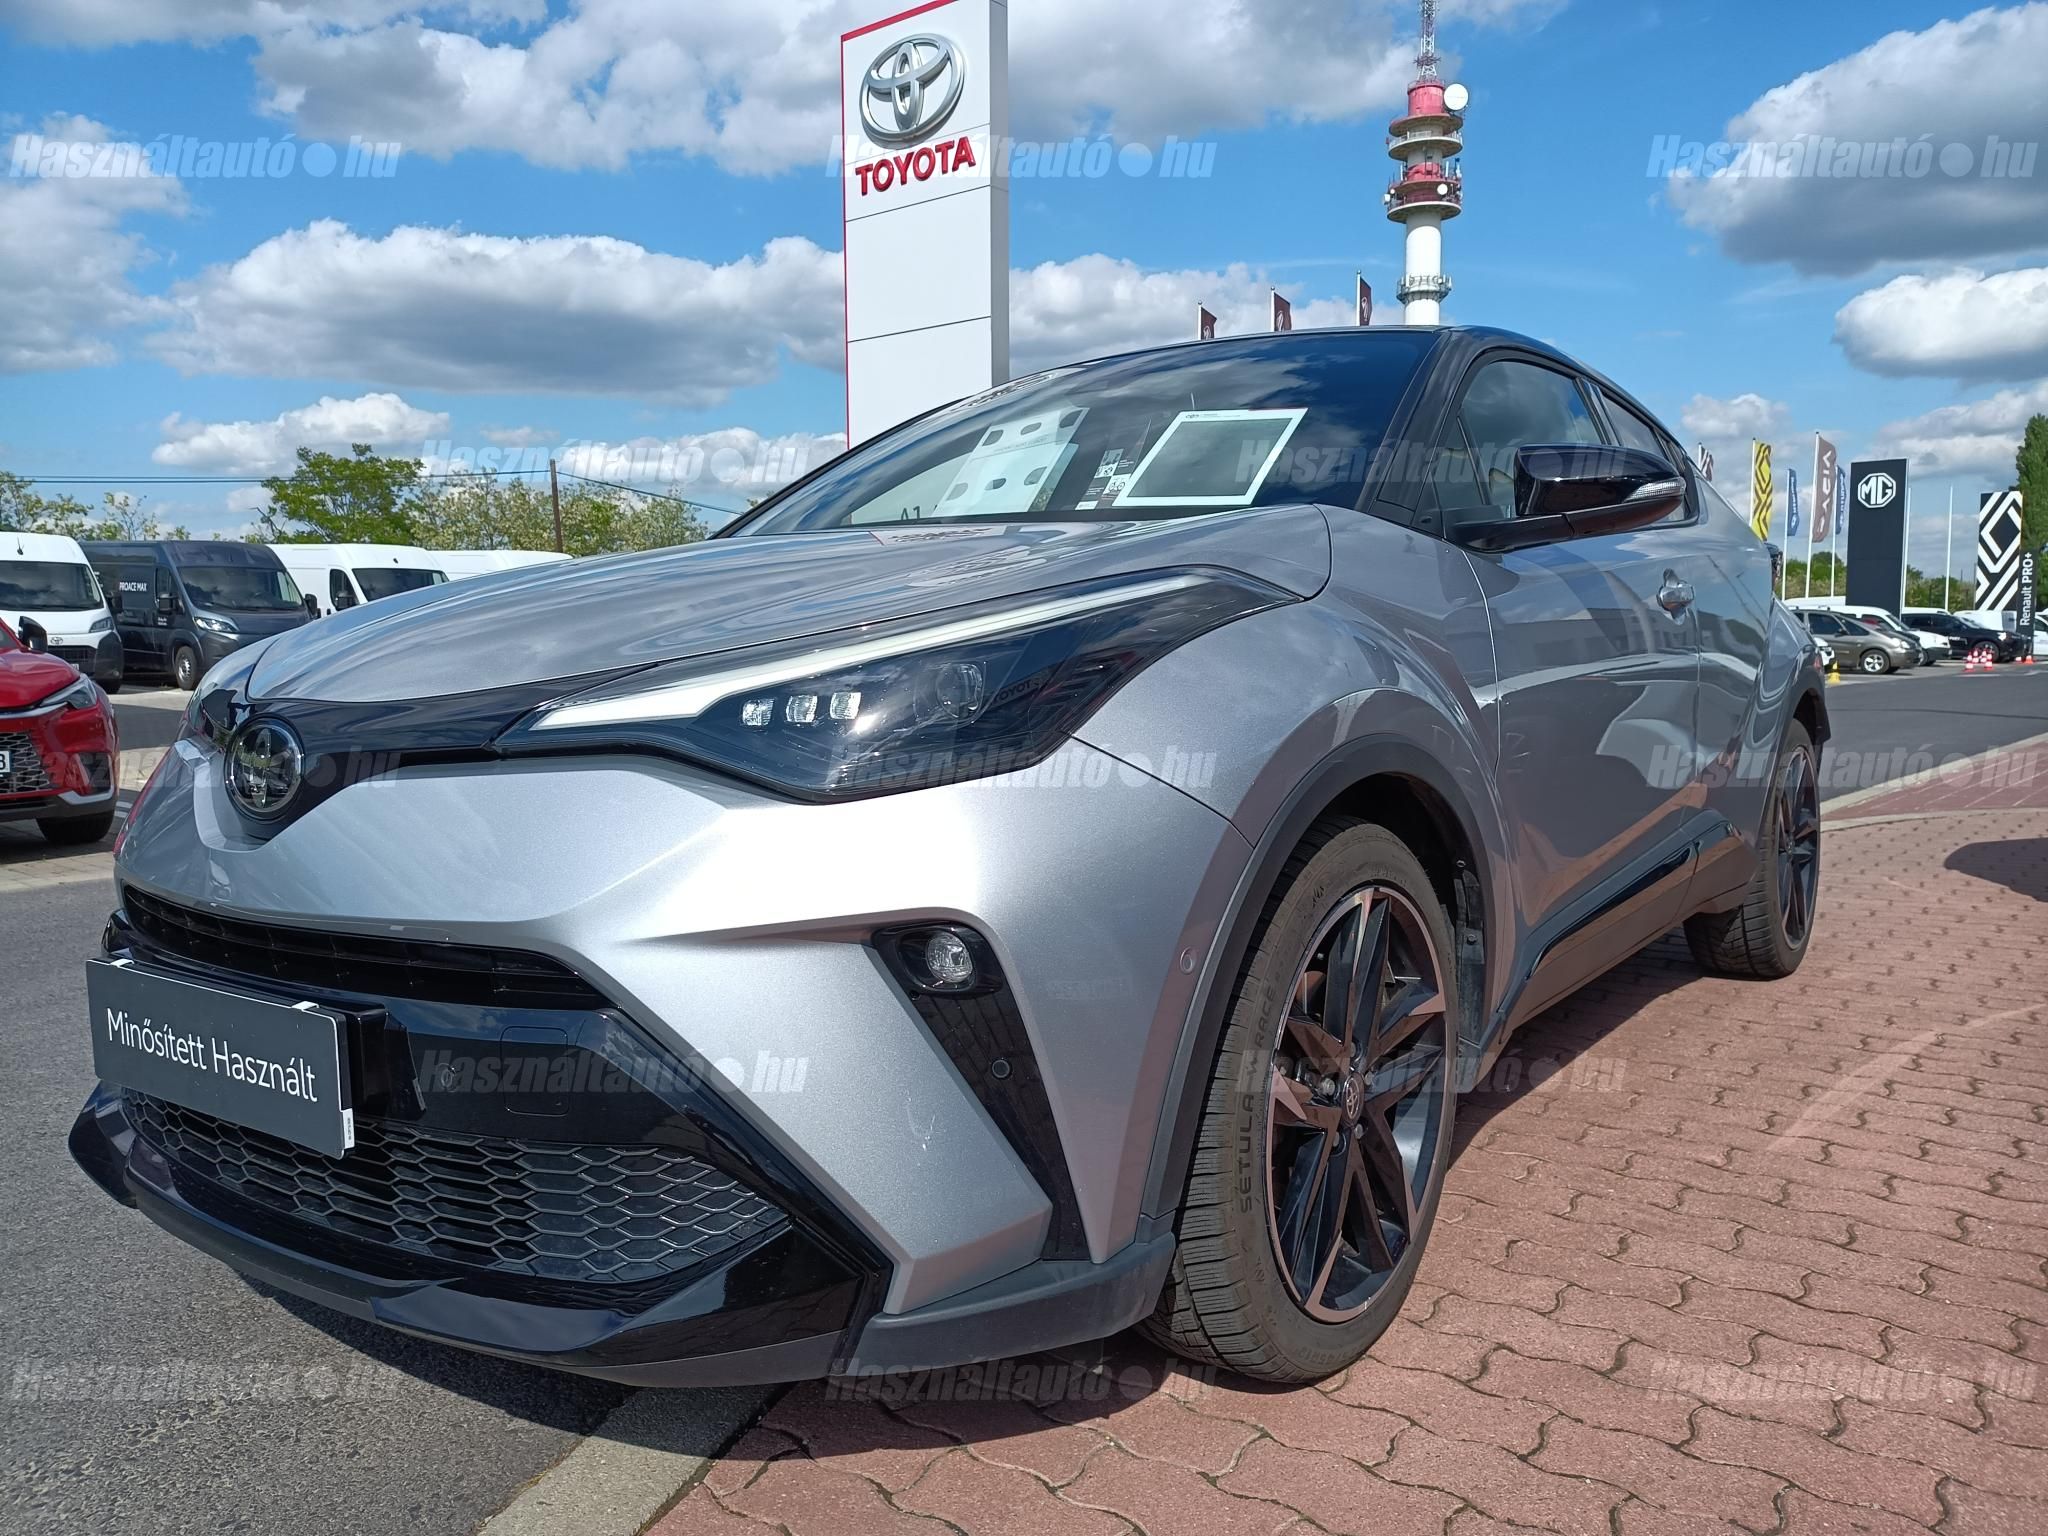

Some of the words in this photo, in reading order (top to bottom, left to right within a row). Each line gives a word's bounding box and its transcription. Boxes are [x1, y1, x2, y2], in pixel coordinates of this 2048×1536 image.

[855, 136, 976, 196] TOYOTA
[1861, 475, 1894, 505] MG
[119, 582, 136, 592] PROACE
[137, 582, 147, 592] MAX
[2021, 552, 2034, 583] PRO+
[2020, 586, 2033, 626] Renault
[106, 1007, 207, 1071] Minősített
[211, 1038, 318, 1103] Használt
[1239, 1094, 1254, 1213] SETULA
